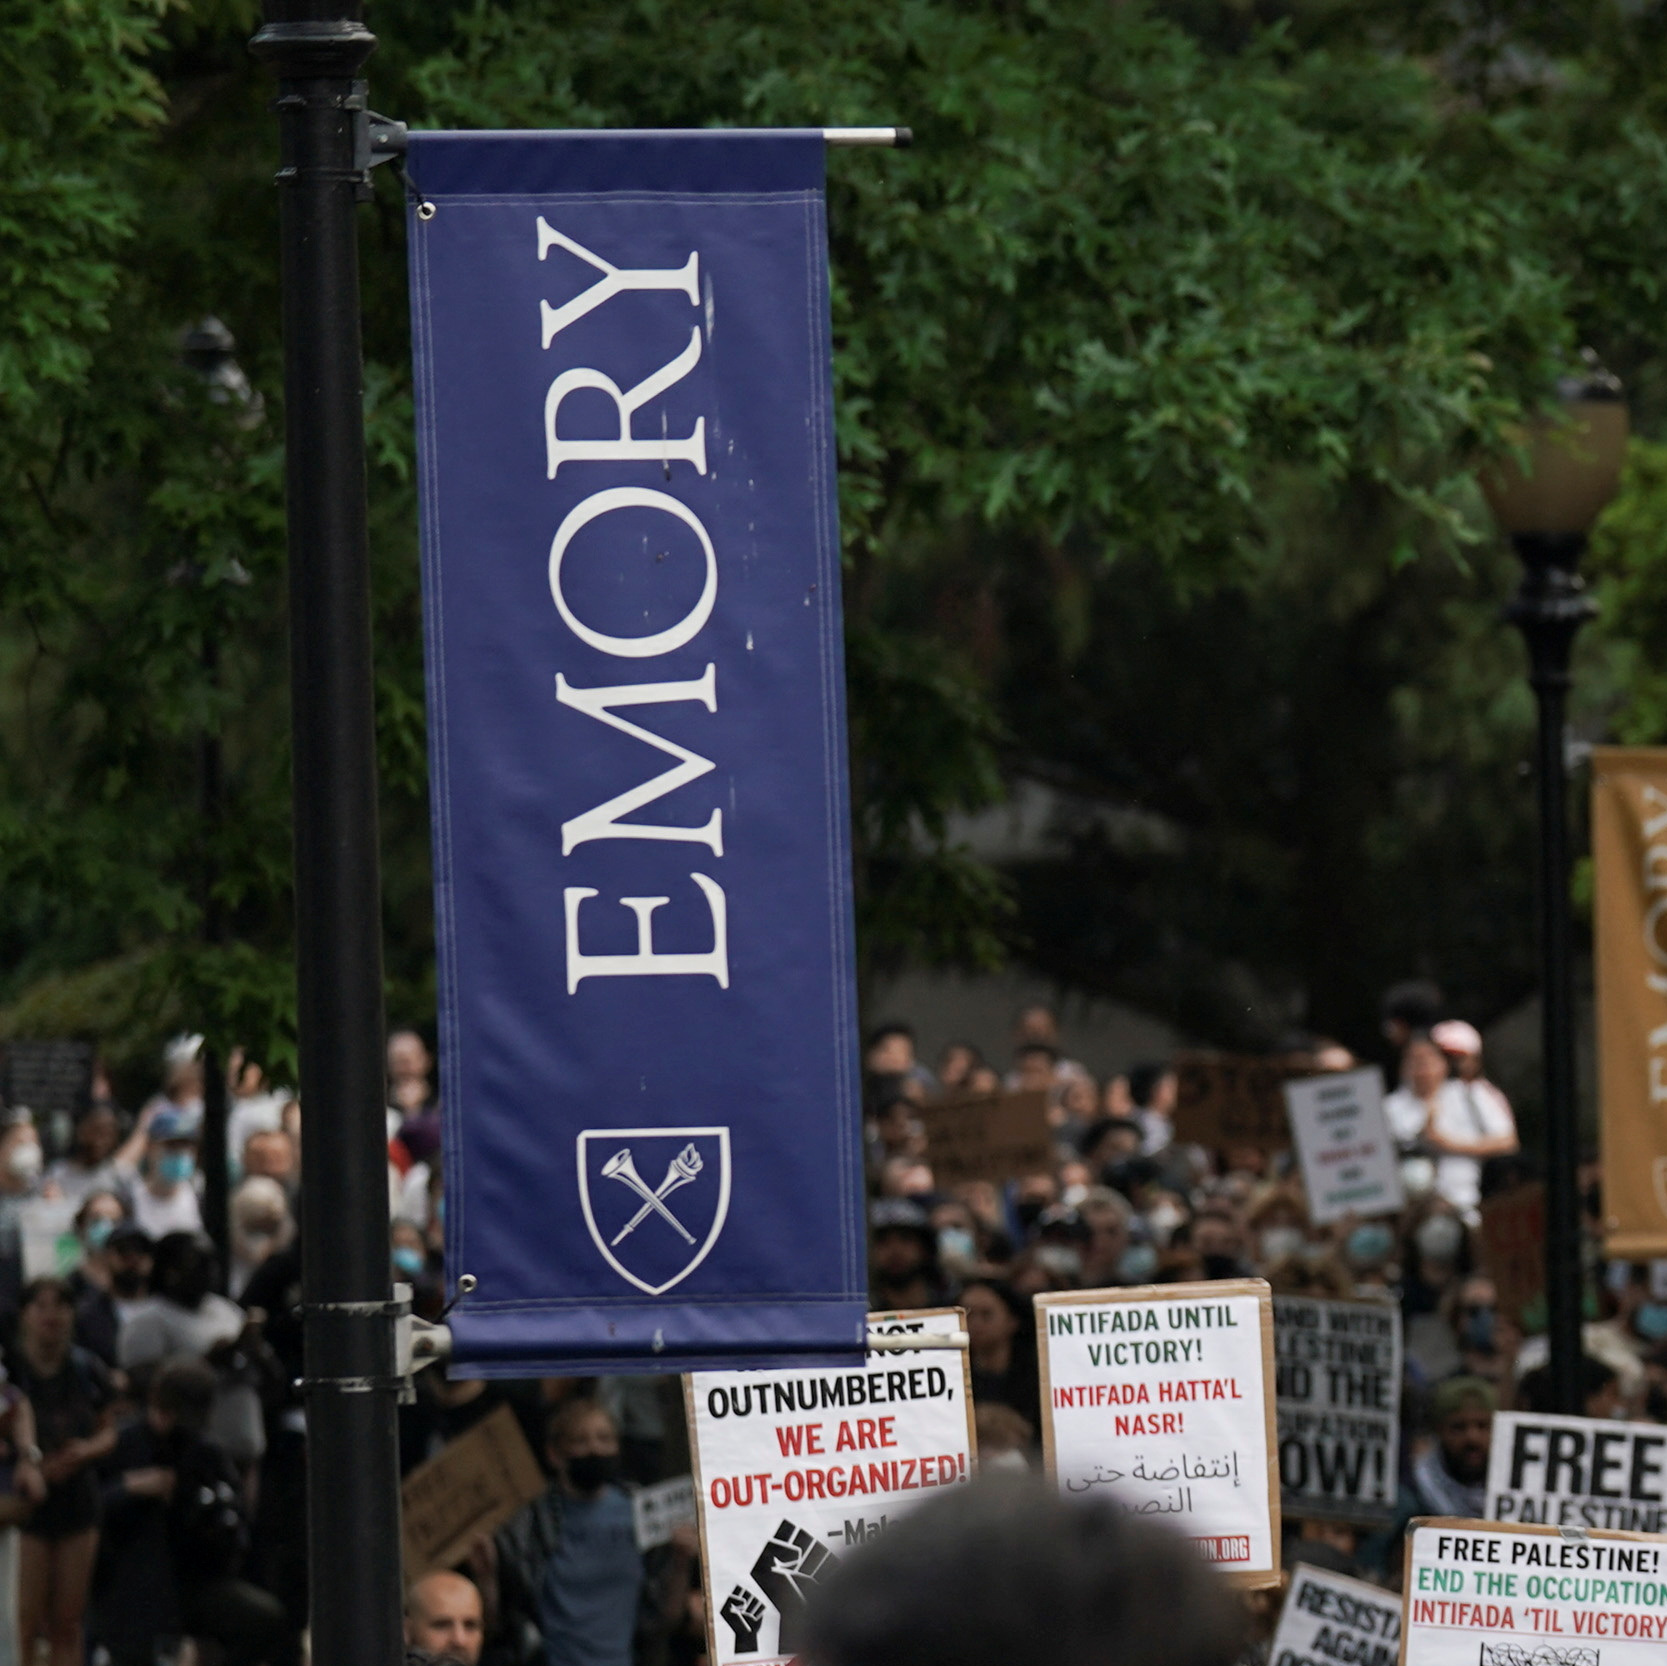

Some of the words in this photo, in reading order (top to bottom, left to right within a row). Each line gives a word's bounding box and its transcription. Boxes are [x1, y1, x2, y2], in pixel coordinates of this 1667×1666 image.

[536, 215, 730, 995] EMORY
[1049, 1309, 1160, 1336] INTIFADA
[1168, 1304, 1238, 1330] UNTIL
[1087, 1338, 1203, 1367] VICTORY!
[707, 1366, 955, 1420] OUTNUMBERED,
[1053, 1383, 1150, 1409] INTIFADA
[775, 1423, 825, 1458] WE
[836, 1416, 898, 1453] ARE
[1114, 1412, 1184, 1437] NASR!
[710, 1452, 968, 1509] OUT-ORGANIZED!
[1279, 1440, 1385, 1499] OW!
[1508, 1423, 1666, 1501] FREE
[1437, 1536, 1501, 1563] FREE
[1511, 1541, 1659, 1574] PALESTINE!
[1417, 1567, 1465, 1594] END
[1473, 1571, 1519, 1598] THE
[1412, 1599, 1515, 1630] INTIFADA
